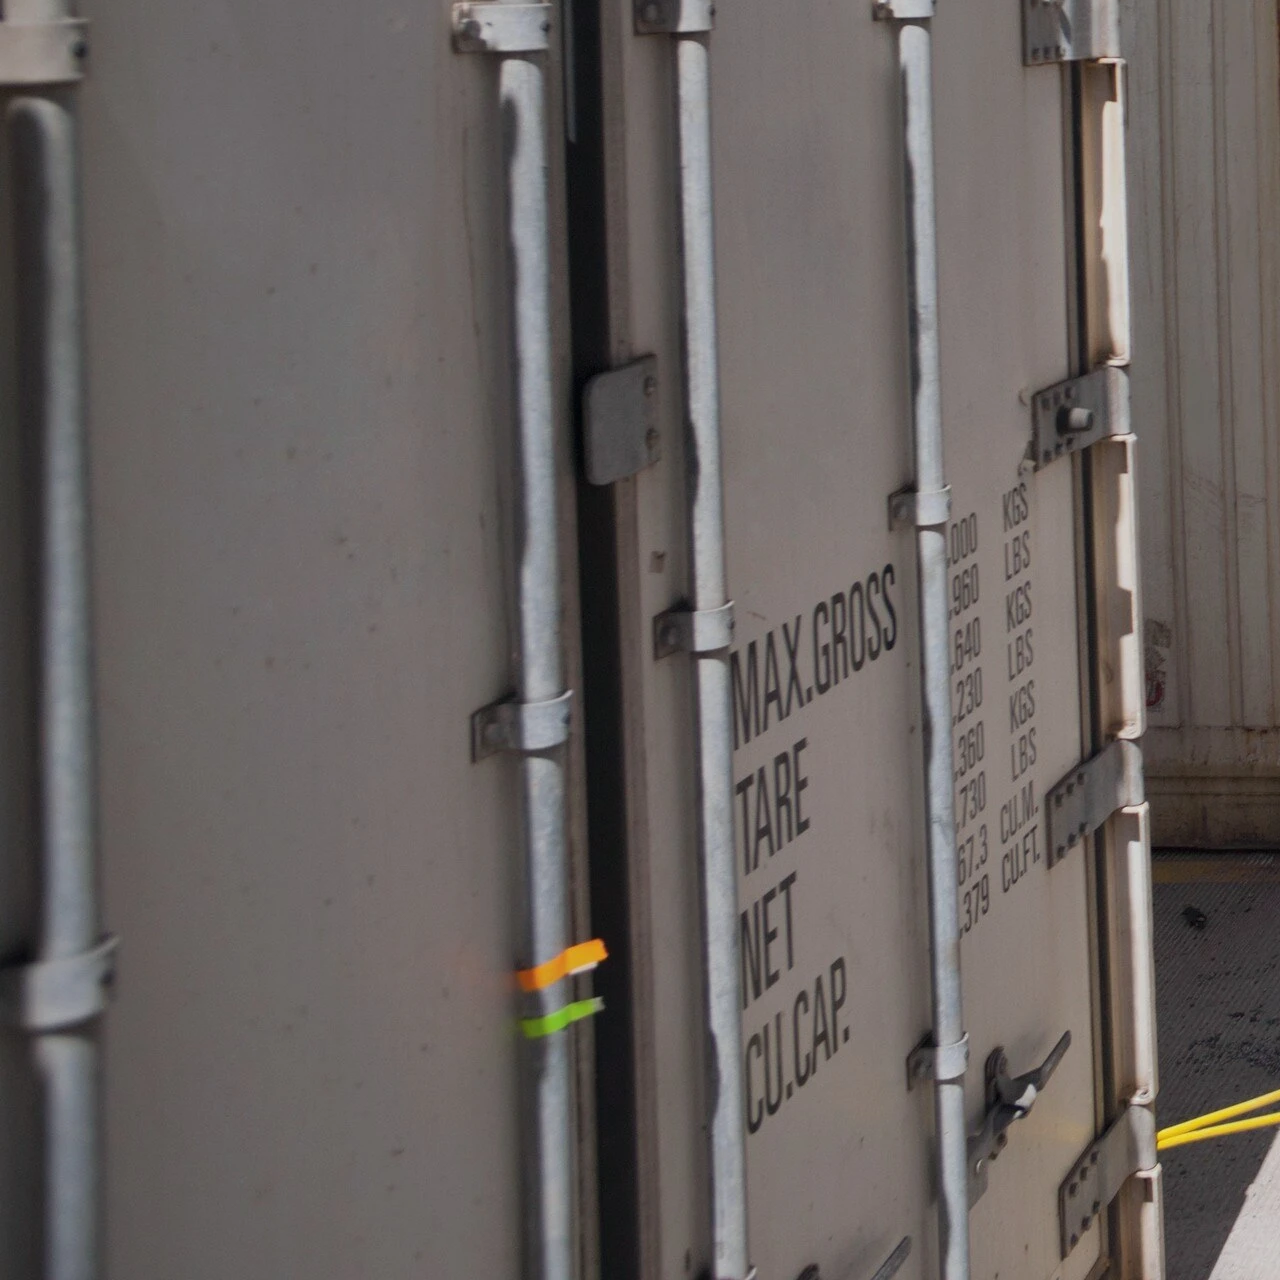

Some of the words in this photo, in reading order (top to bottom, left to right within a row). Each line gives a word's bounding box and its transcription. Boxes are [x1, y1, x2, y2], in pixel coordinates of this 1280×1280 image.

[1003, 481, 1029, 534] KGS
[1004, 528, 1032, 582] LBS
[1006, 580, 1033, 634] KGS
[730, 562, 899, 753] MAX.GROSS
[1008, 628, 1035, 683] LBS
[1009, 678, 1036, 735] KGS
[1011, 726, 1038, 783] LBS
[734, 736, 811, 877] TARE
[740, 870, 798, 1011] NET
[743, 954, 852, 1138] CU.CAP.
